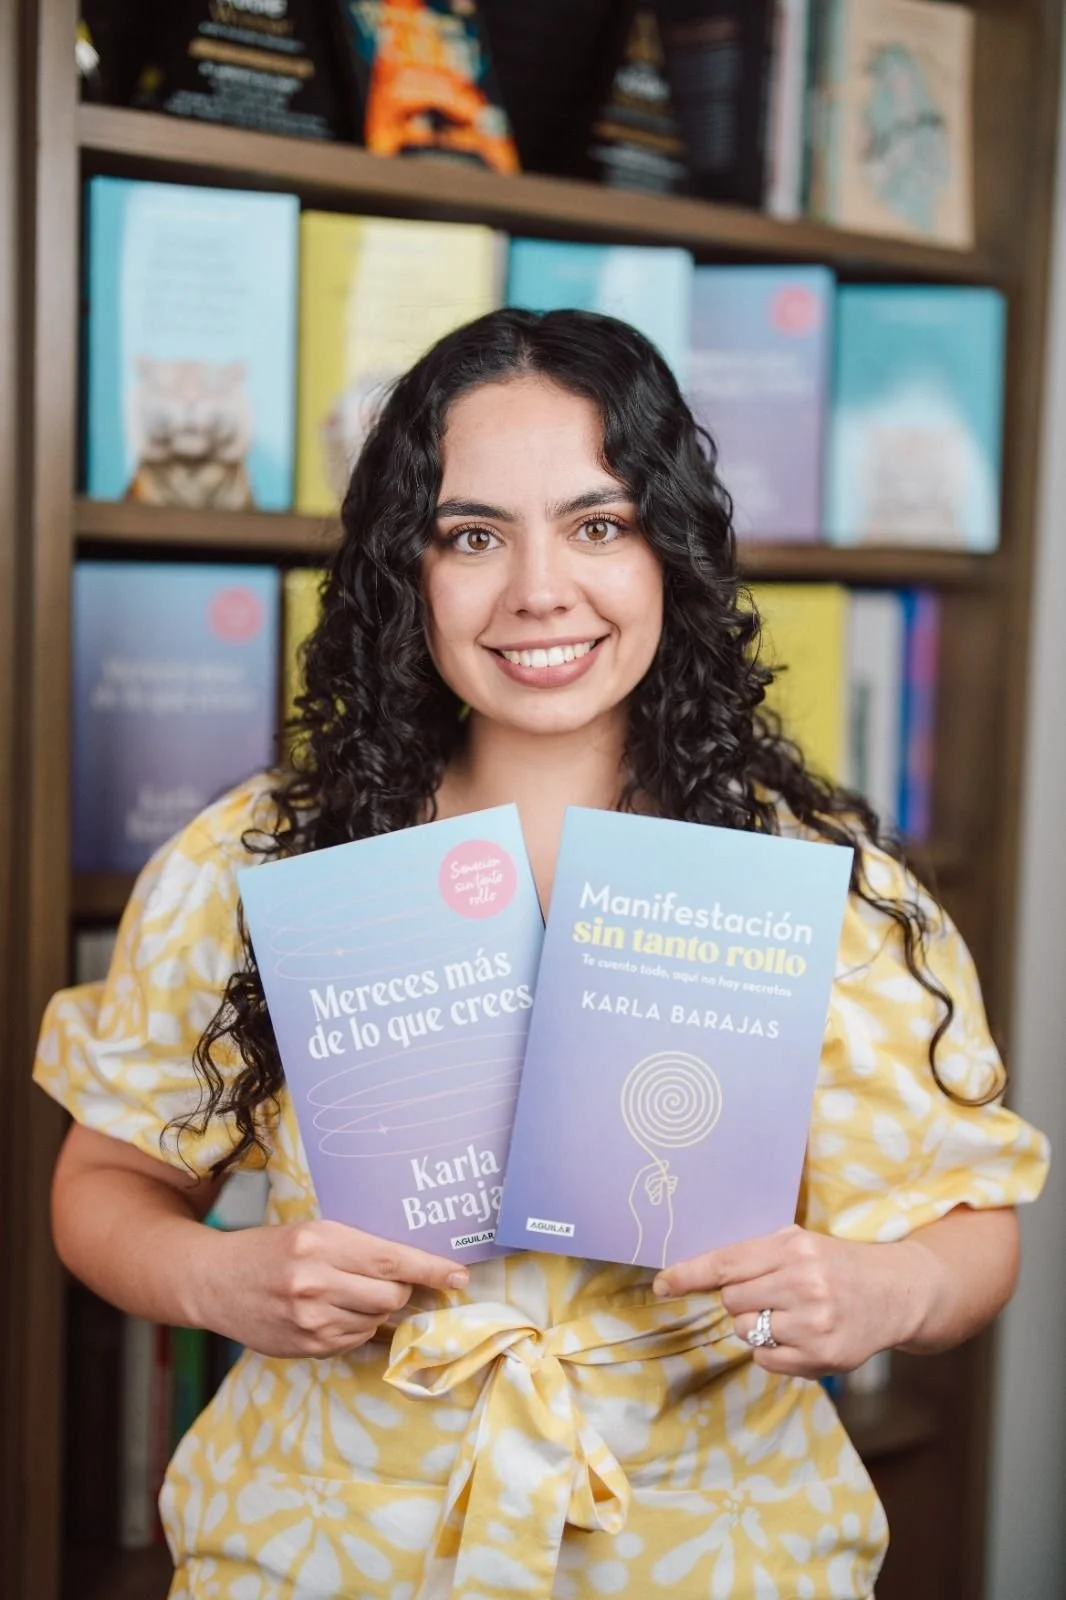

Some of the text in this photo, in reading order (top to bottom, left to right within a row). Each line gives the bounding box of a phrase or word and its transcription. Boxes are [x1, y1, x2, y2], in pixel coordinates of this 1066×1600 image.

[580, 881, 813, 944] Manifestación
[572, 917, 807, 978] sin tanto rollo
[310, 948, 512, 1021] Mereces más
[581, 953, 595, 966] Te
[598, 958, 638, 973] cuento
[640, 964, 670, 979] todo,
[701, 975, 716, 986] no
[718, 976, 741, 992] hay
[742, 982, 792, 998] secretos
[308, 984, 534, 1060] de lo que crees
[582, 991, 781, 1039] KARLA BARAJAS
[410, 1144, 500, 1191] Karla
[402, 1181, 504, 1230] Baraja
[529, 1221, 571, 1234] AGUILAR
[455, 1231, 495, 1247] AGUILAR
